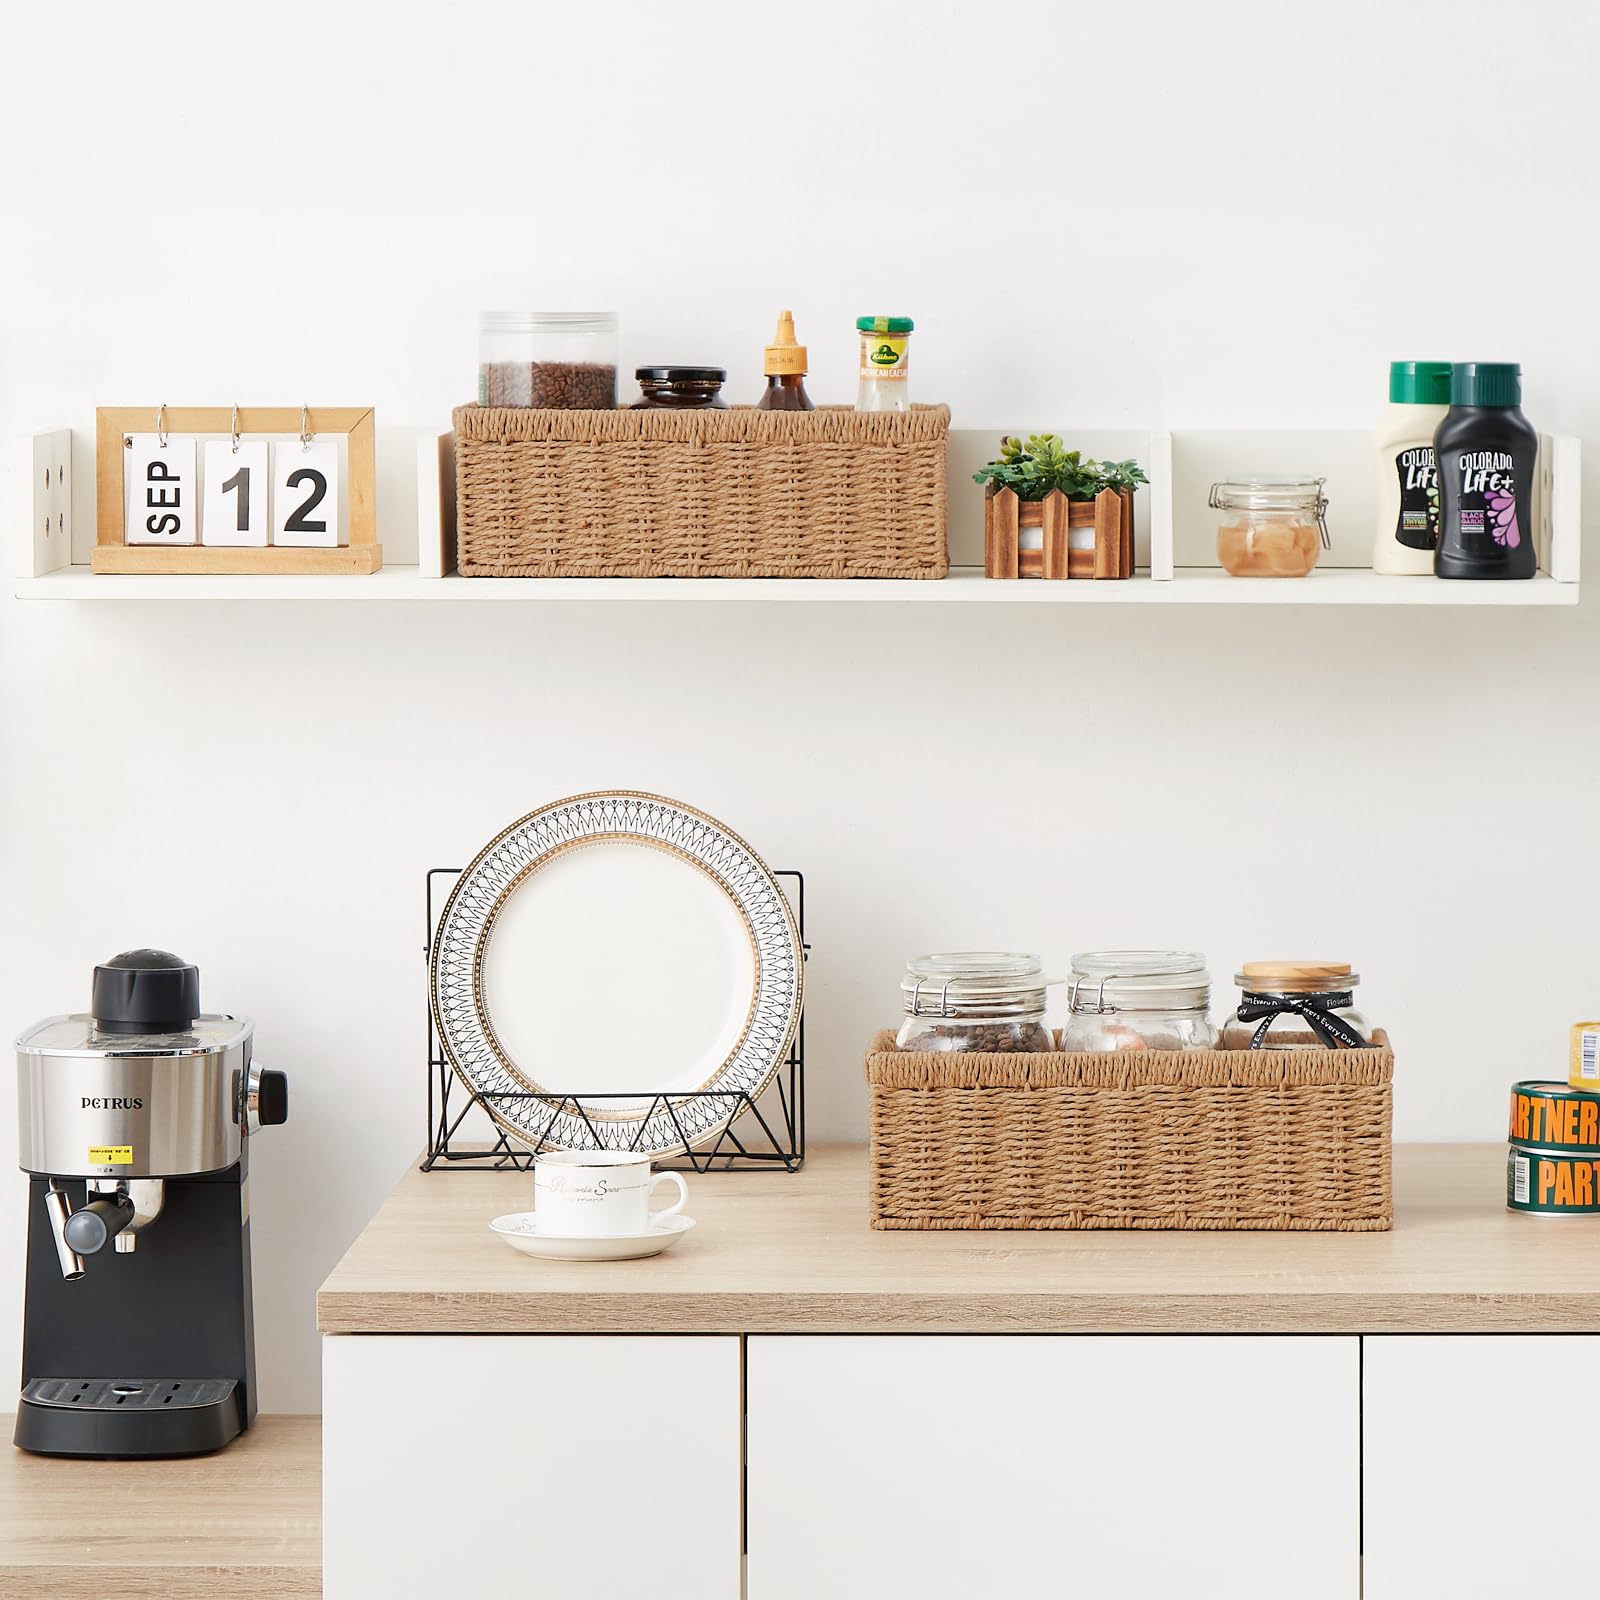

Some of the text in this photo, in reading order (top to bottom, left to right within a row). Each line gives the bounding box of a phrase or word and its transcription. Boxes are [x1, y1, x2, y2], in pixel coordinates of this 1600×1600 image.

[871, 353, 898, 361] Kühne
[861, 368, 889, 377] MERICAN
[1402, 449, 1435, 467] COLOR
[1459, 452, 1514, 471] COLORADO
[146, 460, 181, 535] SEP
[1253, 1020, 1270, 1042] Every
[1303, 1007, 1356, 1046] wers Every Day
[81, 1097, 144, 1109] PETRUS
[1510, 1093, 1600, 1145] ARTNER
